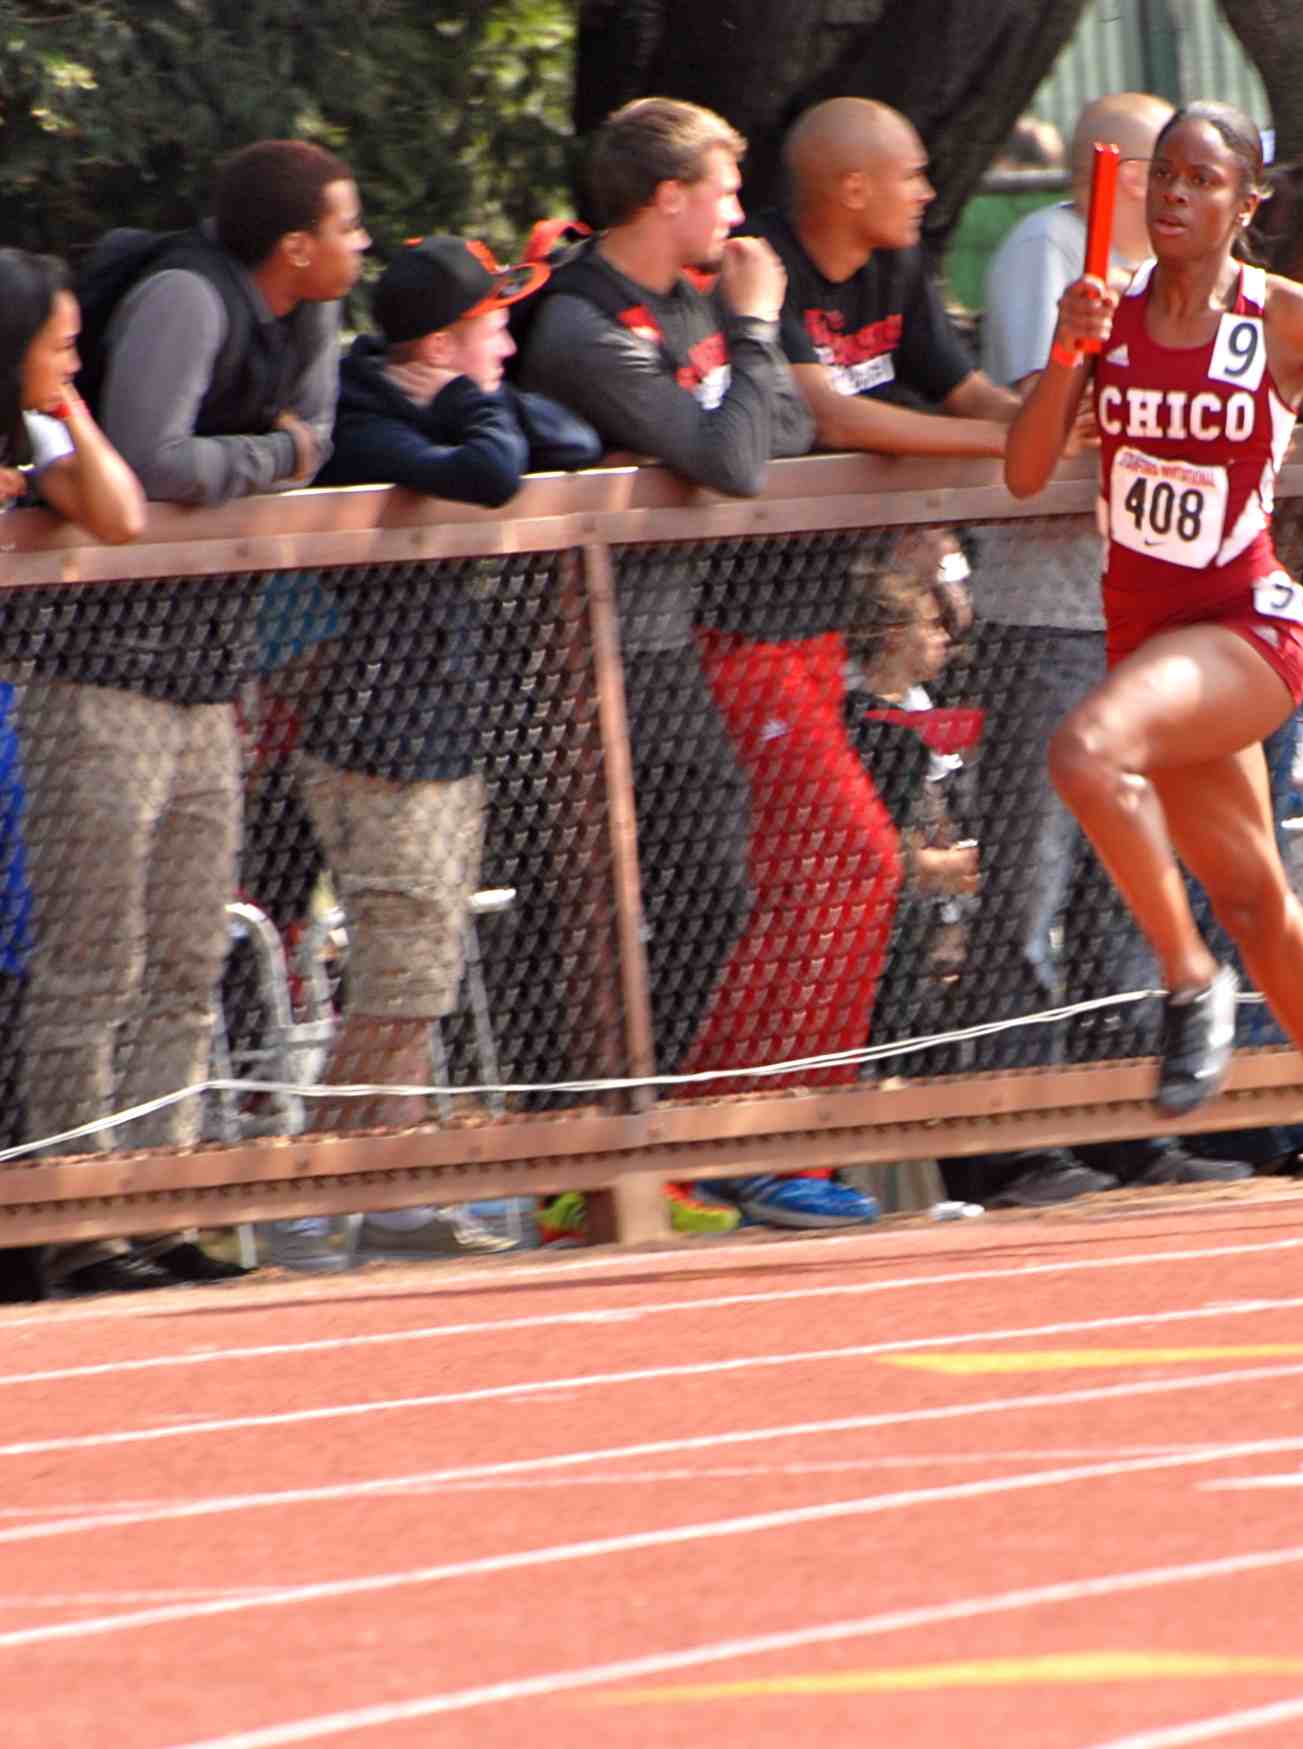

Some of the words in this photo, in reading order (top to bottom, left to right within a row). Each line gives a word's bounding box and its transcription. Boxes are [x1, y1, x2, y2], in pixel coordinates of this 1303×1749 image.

[1223, 322, 1258, 377] 9
[1100, 386, 1255, 442] CHICO
[1125, 477, 1204, 542] 408
